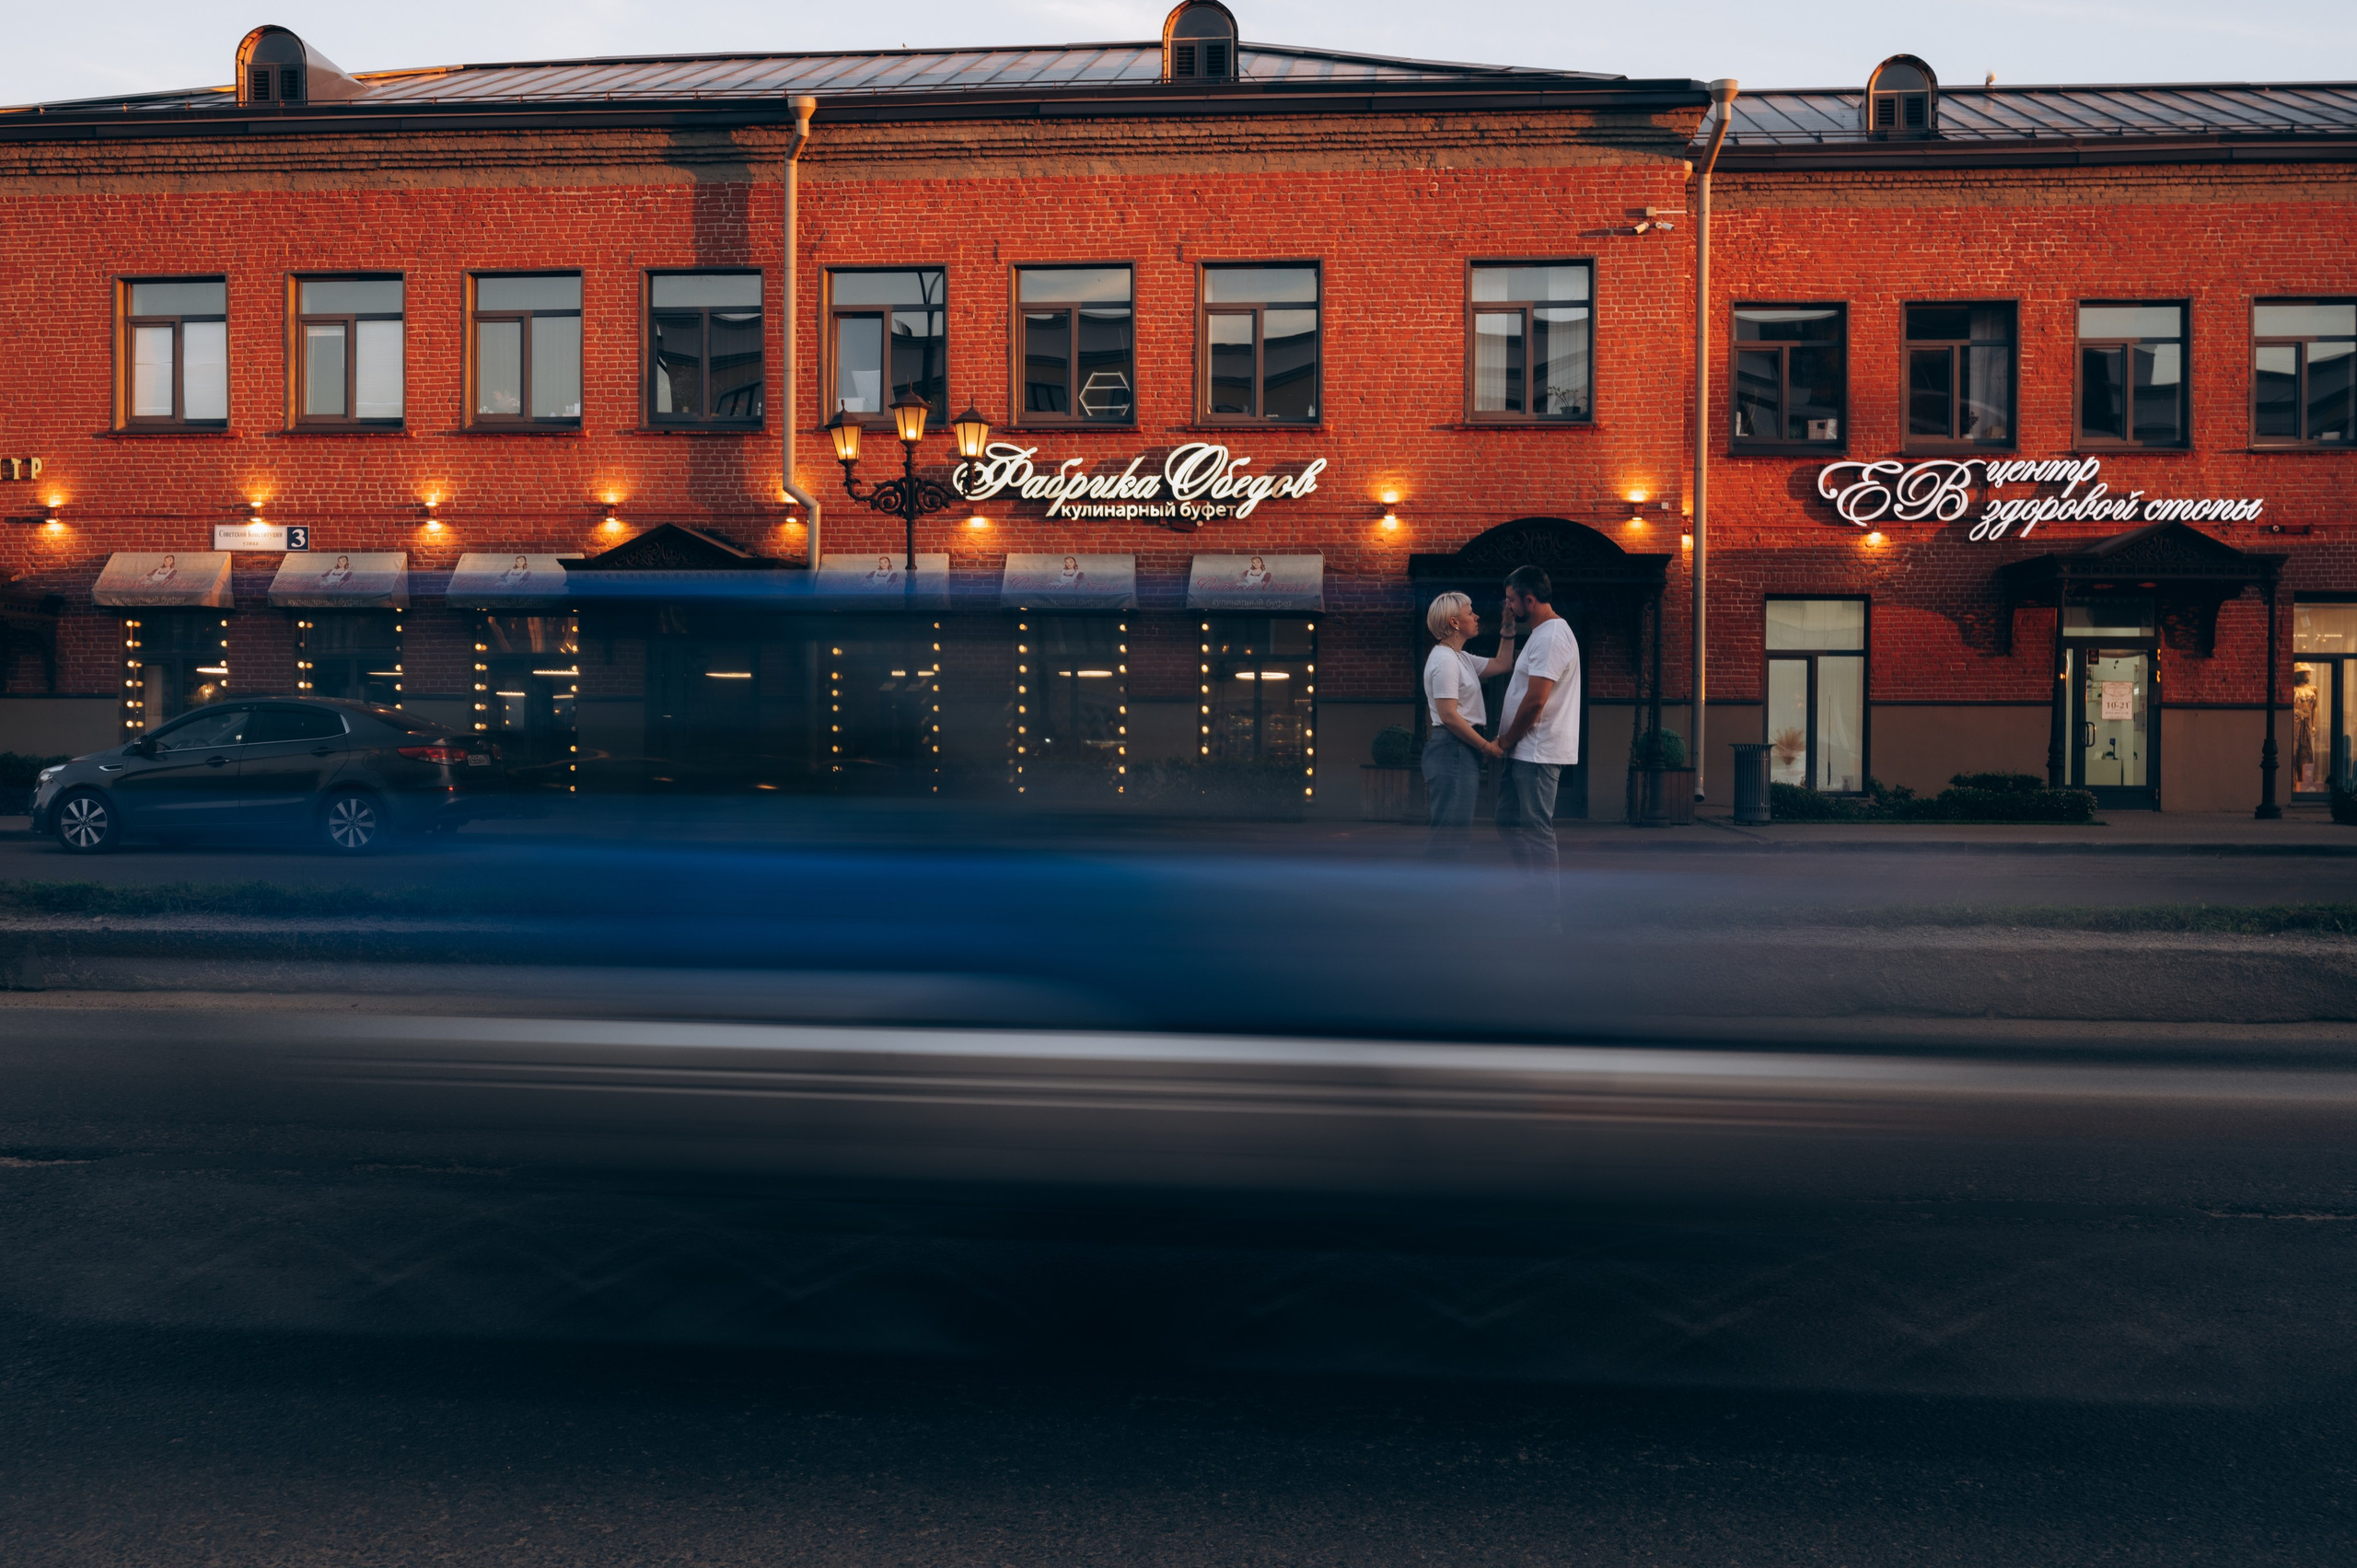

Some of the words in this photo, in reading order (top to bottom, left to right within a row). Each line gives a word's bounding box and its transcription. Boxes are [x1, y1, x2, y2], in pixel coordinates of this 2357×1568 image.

[0, 457, 42, 480] ТР
[1985, 456, 2100, 498] центр
[952, 442, 1161, 517] Фабрика
[1166, 442, 1327, 519] Обедов
[1061, 501, 1176, 521] кулинарный
[1180, 501, 1237, 521] буфет
[1968, 482, 2145, 541] здоровой
[2144, 498, 2264, 521] стопы
[218, 529, 247, 538] Советской
[291, 528, 306, 548] 3
[111, 596, 159, 605] кулинарный
[161, 596, 187, 605] буфет
[287, 598, 337, 607] кулинарный
[338, 598, 363, 607] буфет
[1212, 598, 1264, 608] кулинарный
[1266, 599, 1293, 609] буфет
